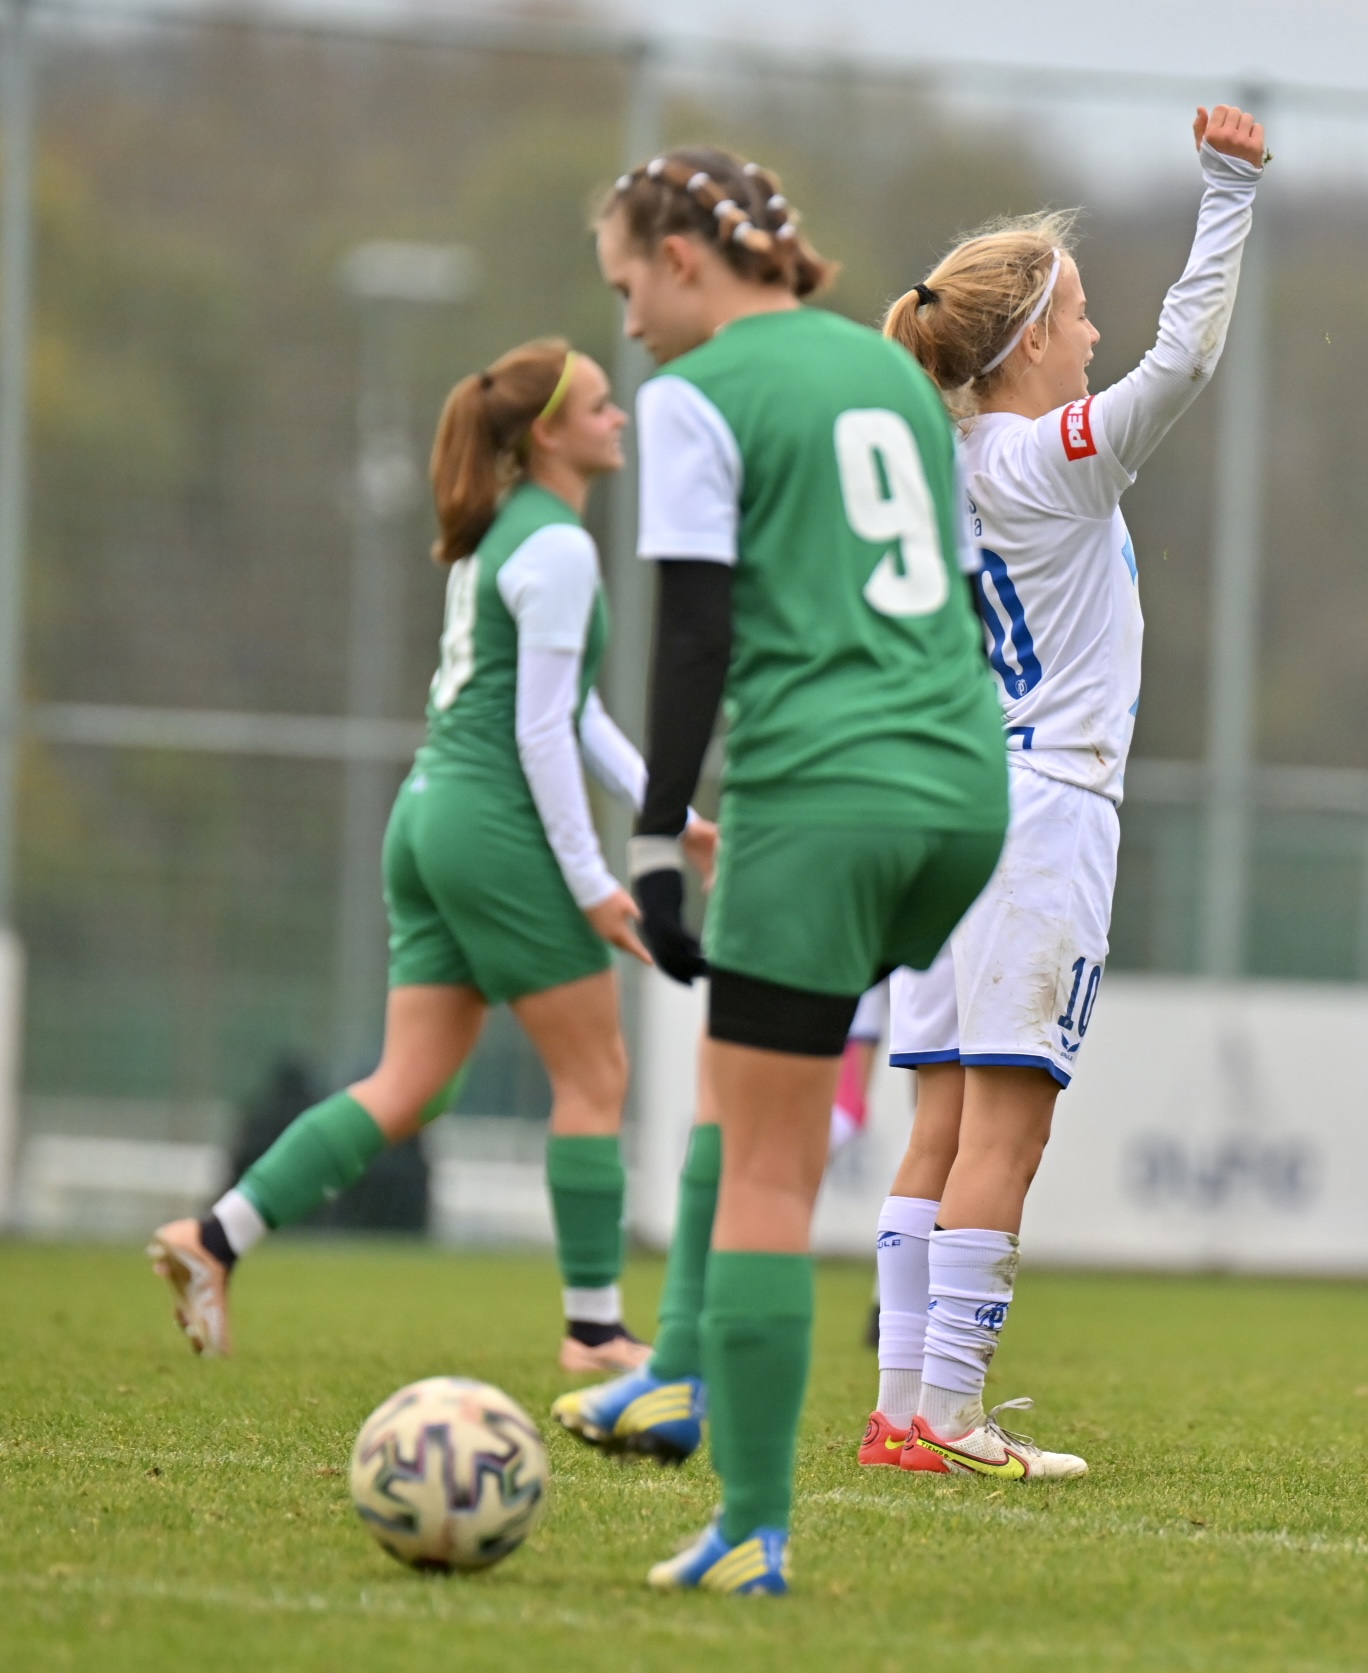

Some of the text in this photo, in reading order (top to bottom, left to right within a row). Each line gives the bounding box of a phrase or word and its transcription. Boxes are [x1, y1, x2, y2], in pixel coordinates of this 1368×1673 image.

[835, 409, 947, 617] 9
[1057, 956, 1101, 1037] 10
[877, 1239, 901, 1249] ULE
